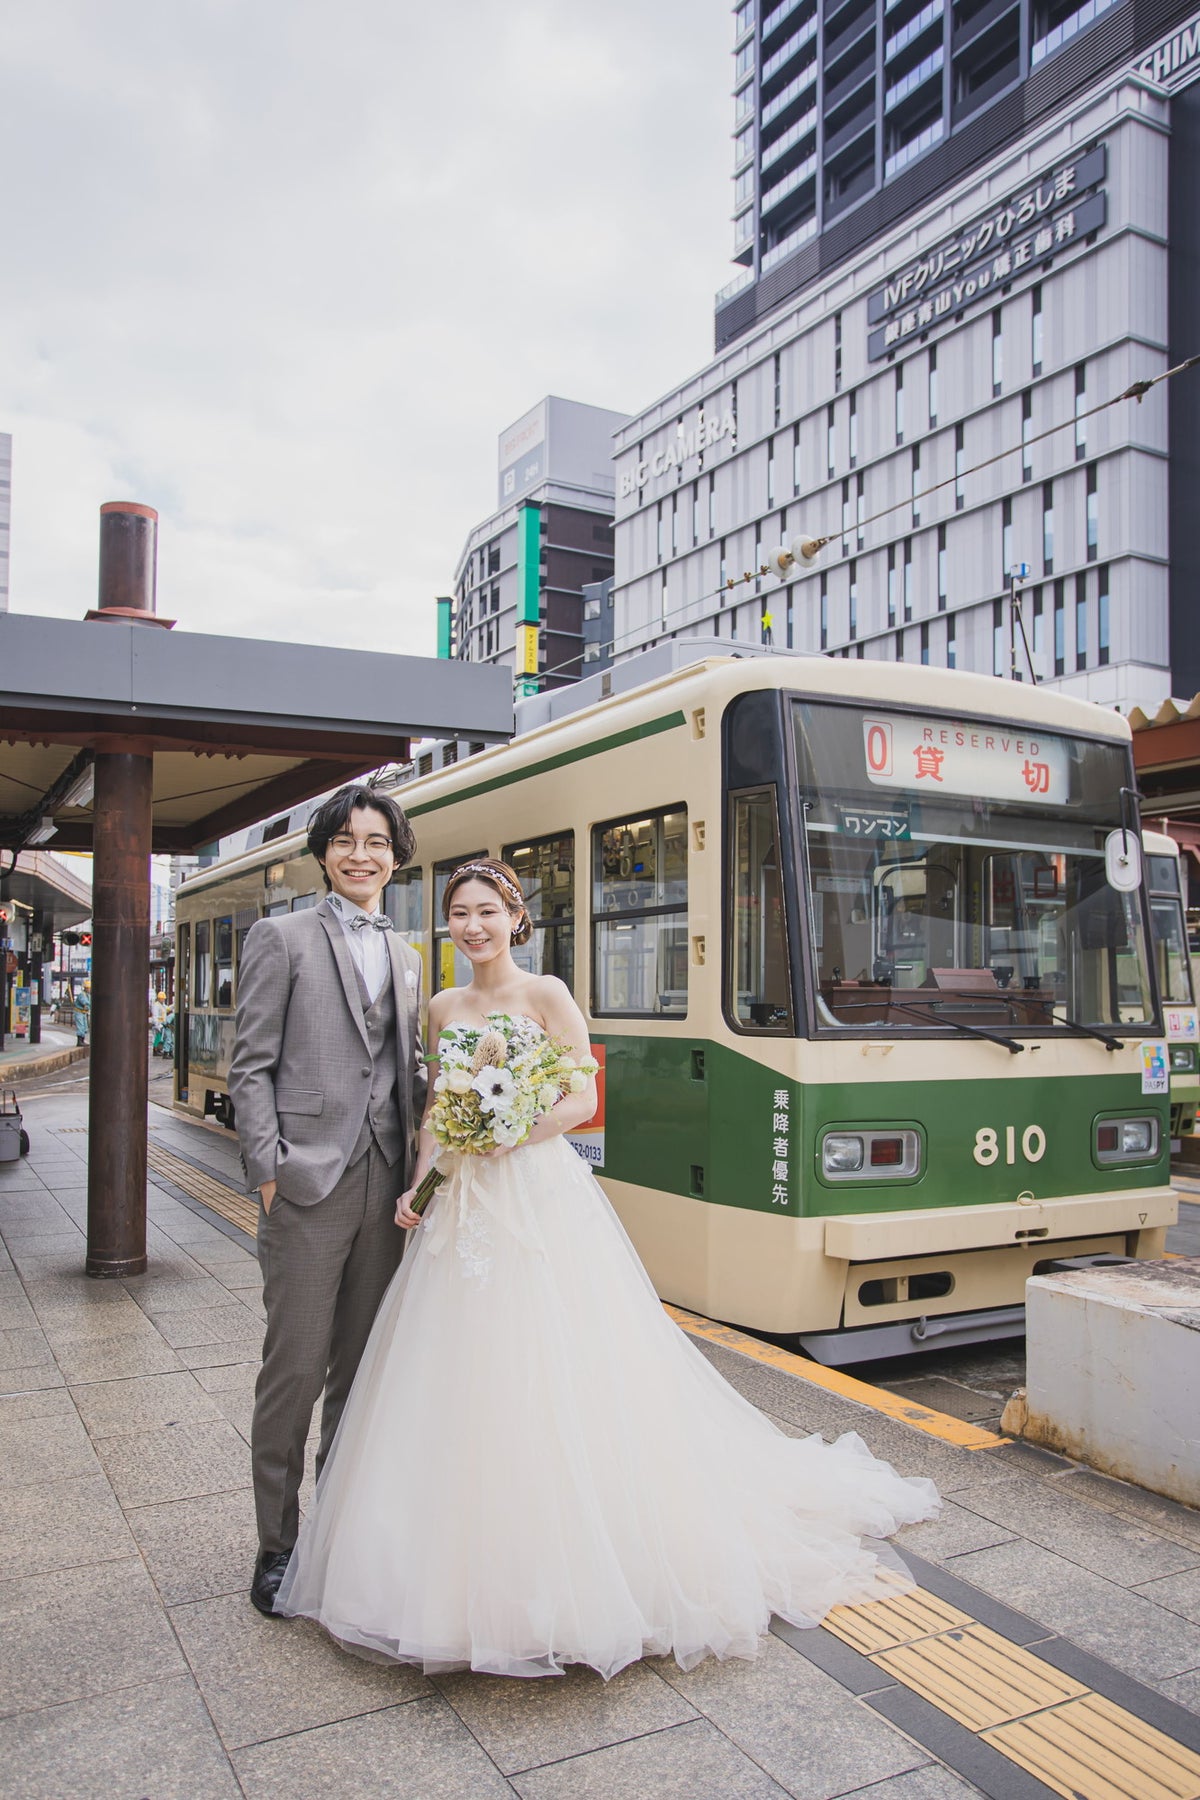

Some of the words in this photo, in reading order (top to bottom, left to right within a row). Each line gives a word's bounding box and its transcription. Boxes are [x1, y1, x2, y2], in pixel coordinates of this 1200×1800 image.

[883, 167, 1076, 310] IVFクリニックひろしま
[620, 461, 650, 499] BIC
[651, 409, 737, 479] CAMERA
[867, 725, 888, 771] 0
[923, 727, 1040, 756] RESERVED
[844, 816, 908, 837] ワンマン
[1144, 1079, 1166, 1090] PASPY
[772, 1089, 790, 1206] 乗降者優先
[973, 1124, 1046, 1166] 810
